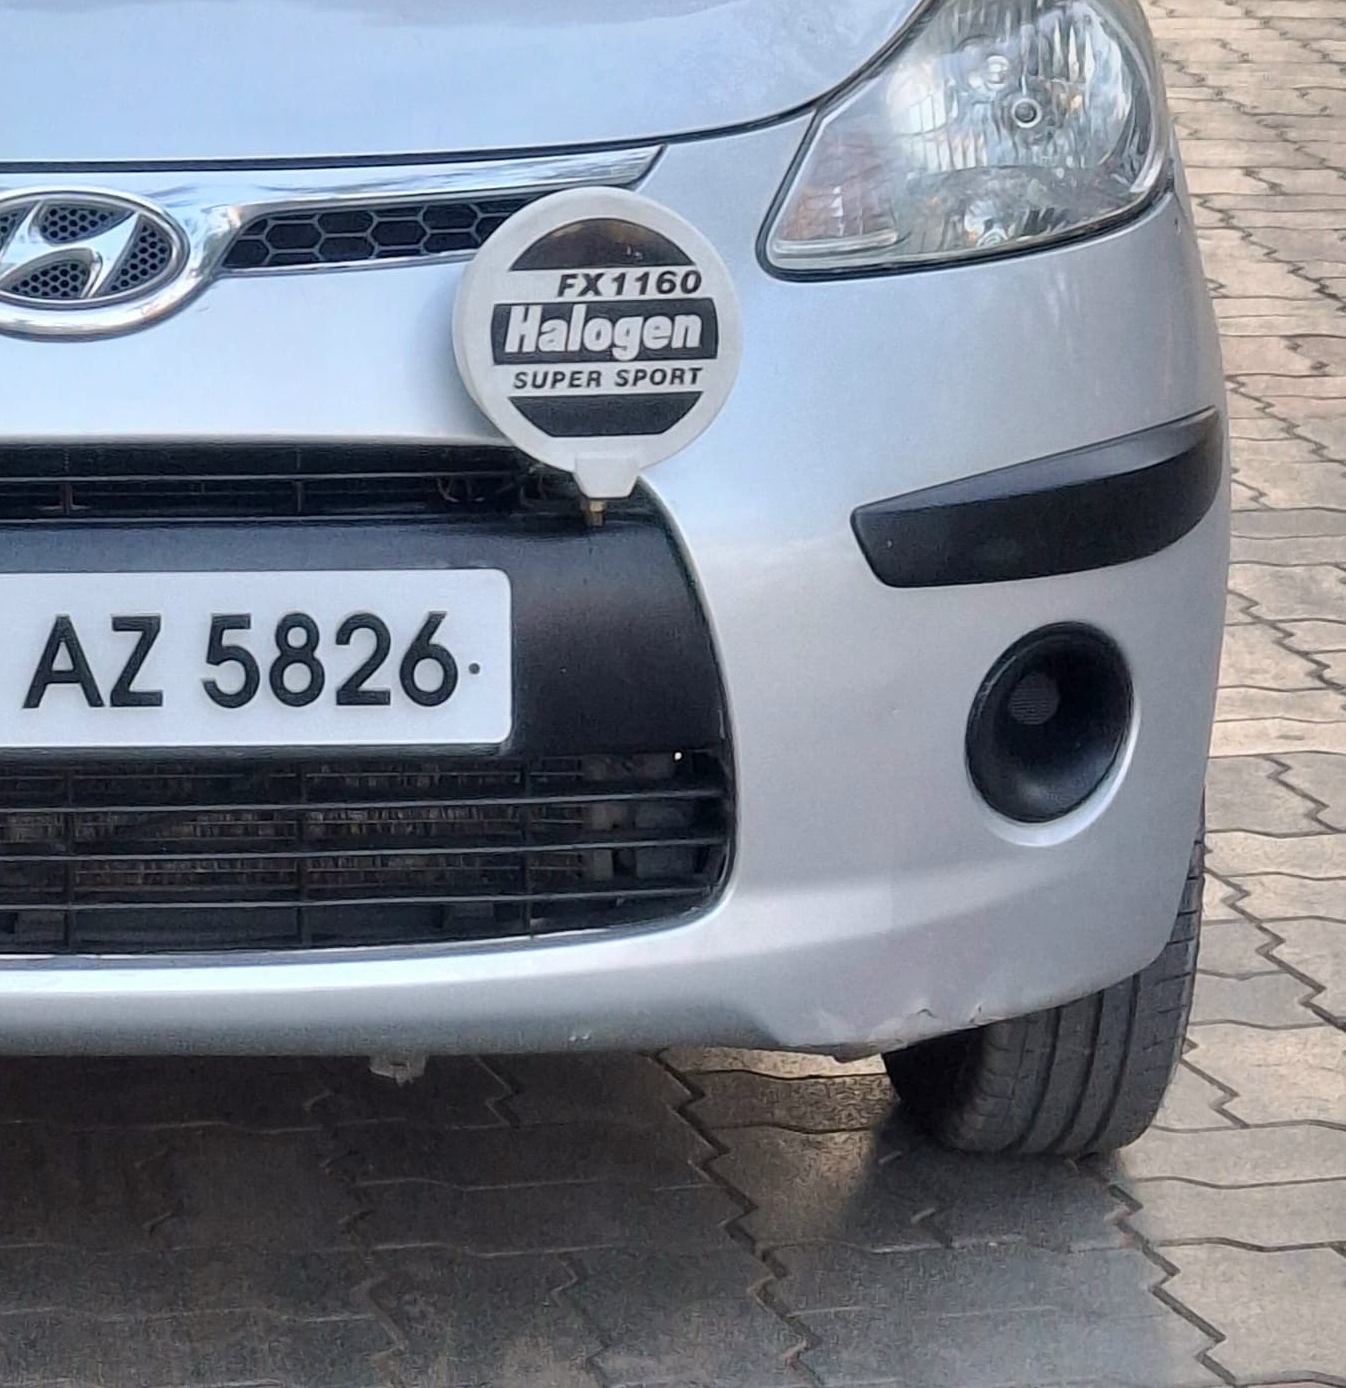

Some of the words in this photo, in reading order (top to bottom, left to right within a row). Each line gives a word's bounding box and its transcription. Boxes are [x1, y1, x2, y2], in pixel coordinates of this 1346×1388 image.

[557, 270, 702, 298] FX1160
[504, 303, 702, 362] Halogen
[513, 370, 602, 390] SUPER
[614, 366, 703, 387] SPORT
[21, 615, 164, 709] AZ
[202, 611, 459, 709] 5826
